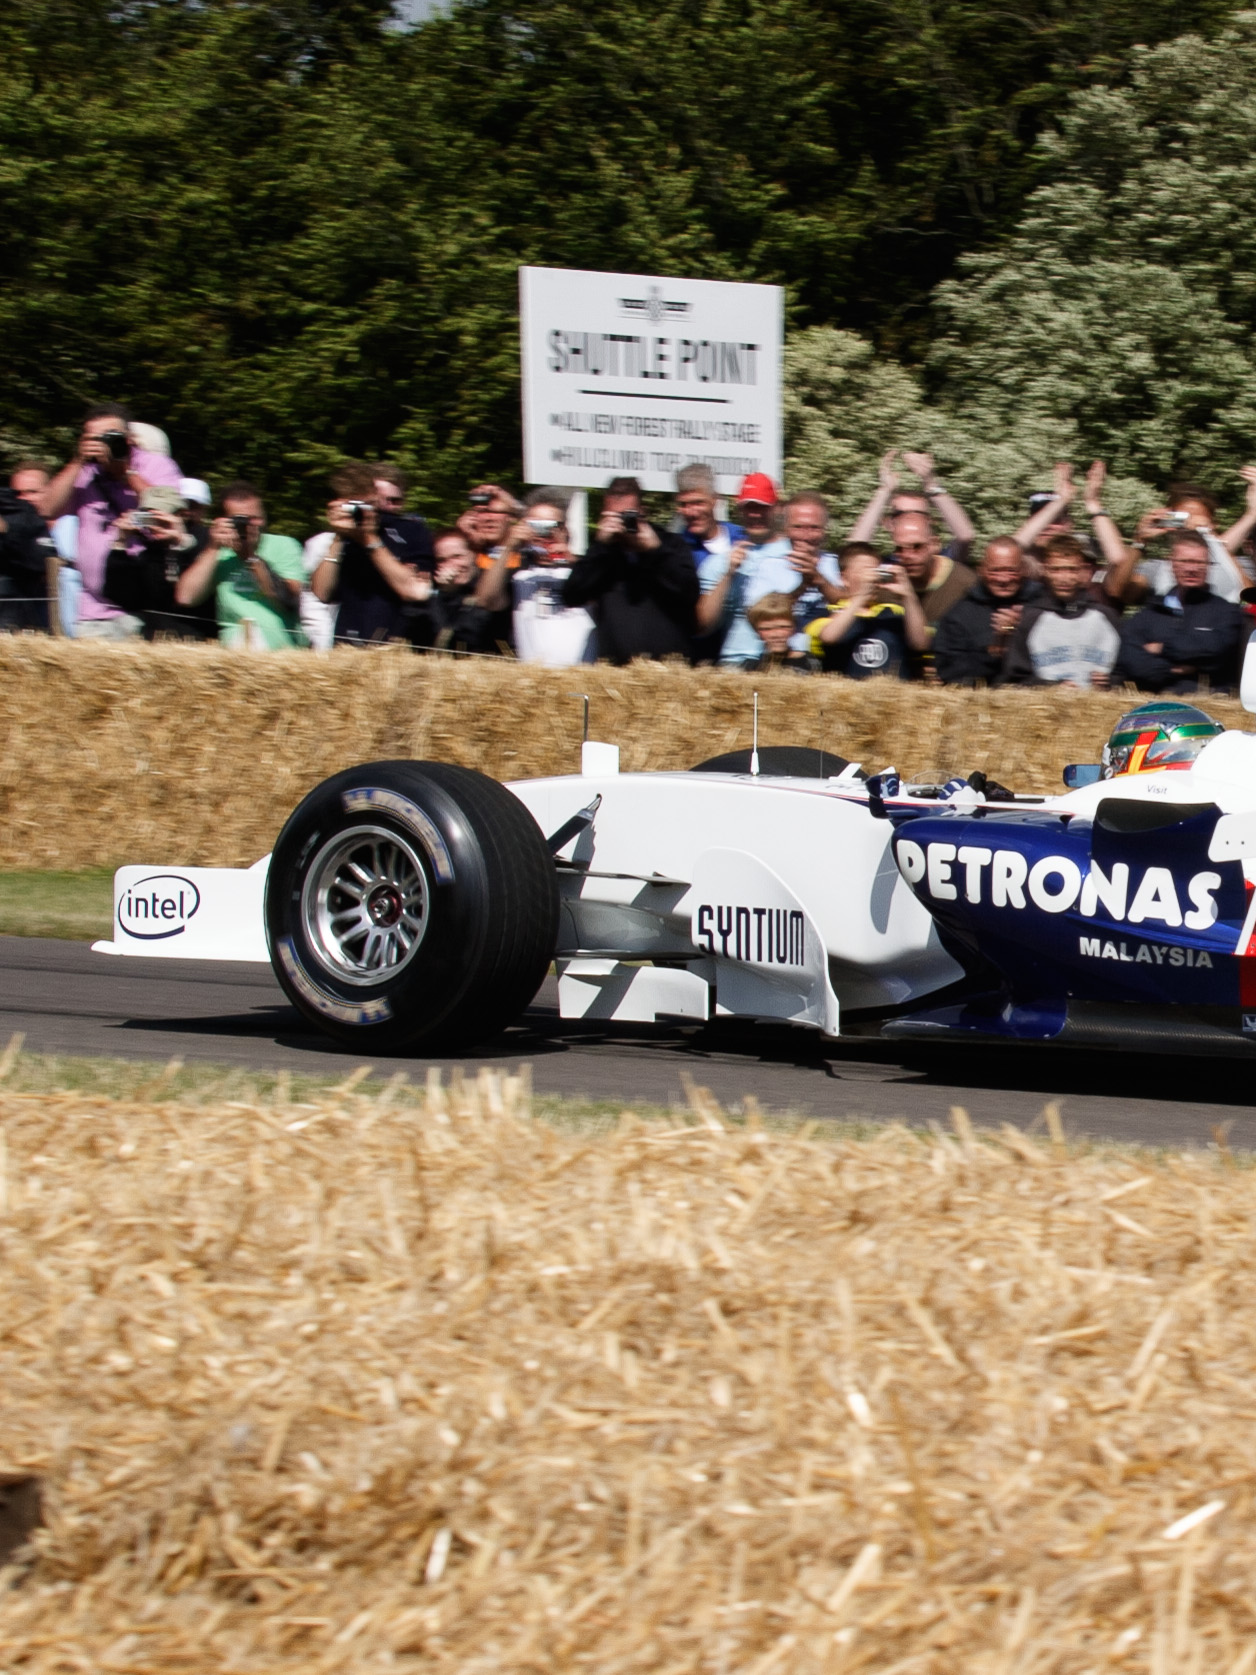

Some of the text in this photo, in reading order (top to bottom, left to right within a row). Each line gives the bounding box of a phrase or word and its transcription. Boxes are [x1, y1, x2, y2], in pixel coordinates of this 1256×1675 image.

[548, 328, 760, 386] SHUTTLE POINT
[1147, 784, 1168, 795] Visit
[127, 888, 185, 920] intel
[896, 838, 1223, 930] PETRONAS
[698, 904, 805, 967] SYNTIUM
[1078, 936, 1214, 969] MALAYSIA
